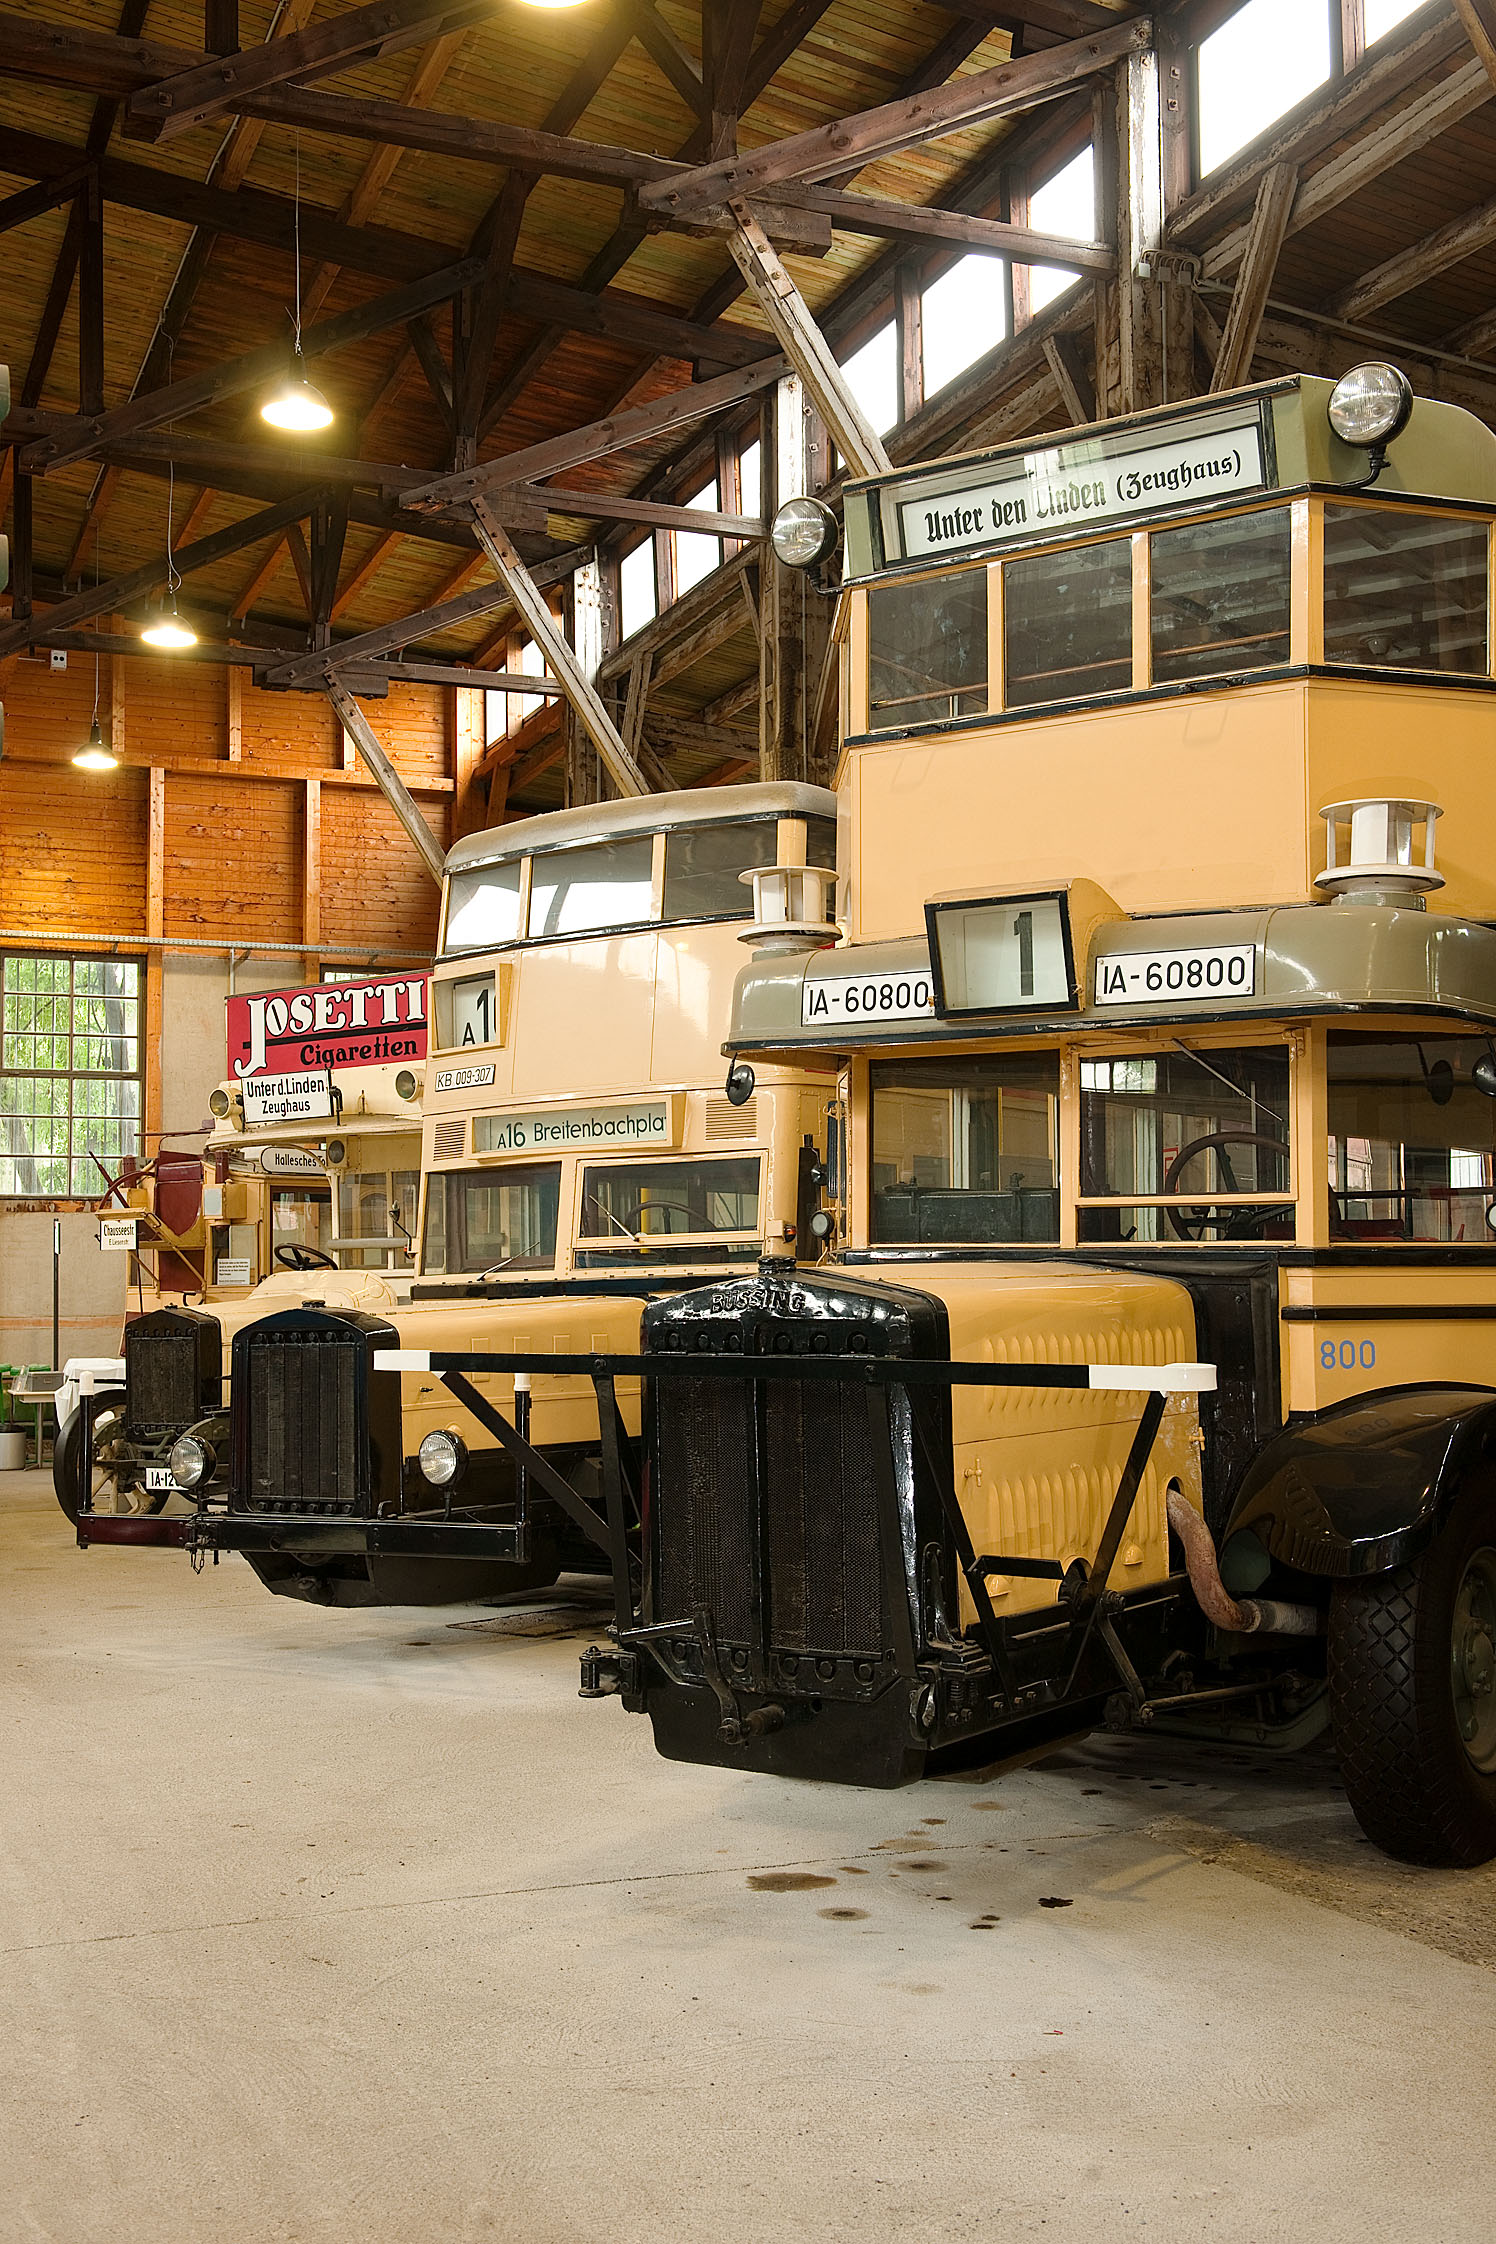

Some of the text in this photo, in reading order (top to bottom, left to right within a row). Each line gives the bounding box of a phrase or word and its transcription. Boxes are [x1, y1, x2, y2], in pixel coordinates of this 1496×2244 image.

[925, 508, 984, 543] Unter
[992, 498, 1027, 529] den
[1013, 912, 1033, 996] 1
[1103, 956, 1247, 995] IA-60800
[809, 981, 930, 1017] IA-60800
[234, 980, 425, 1077] JOSETTI
[300, 1037, 418, 1069] Cigaretten
[247, 1083, 277, 1098] Unter
[437, 1067, 491, 1088] KB 009-307
[262, 1099, 311, 1117] Zeughaus
[497, 1113, 667, 1149] A16 Breitenbachpla
[275, 1153, 316, 1167] Hallesches
[1320, 1340, 1376, 1369] 800
